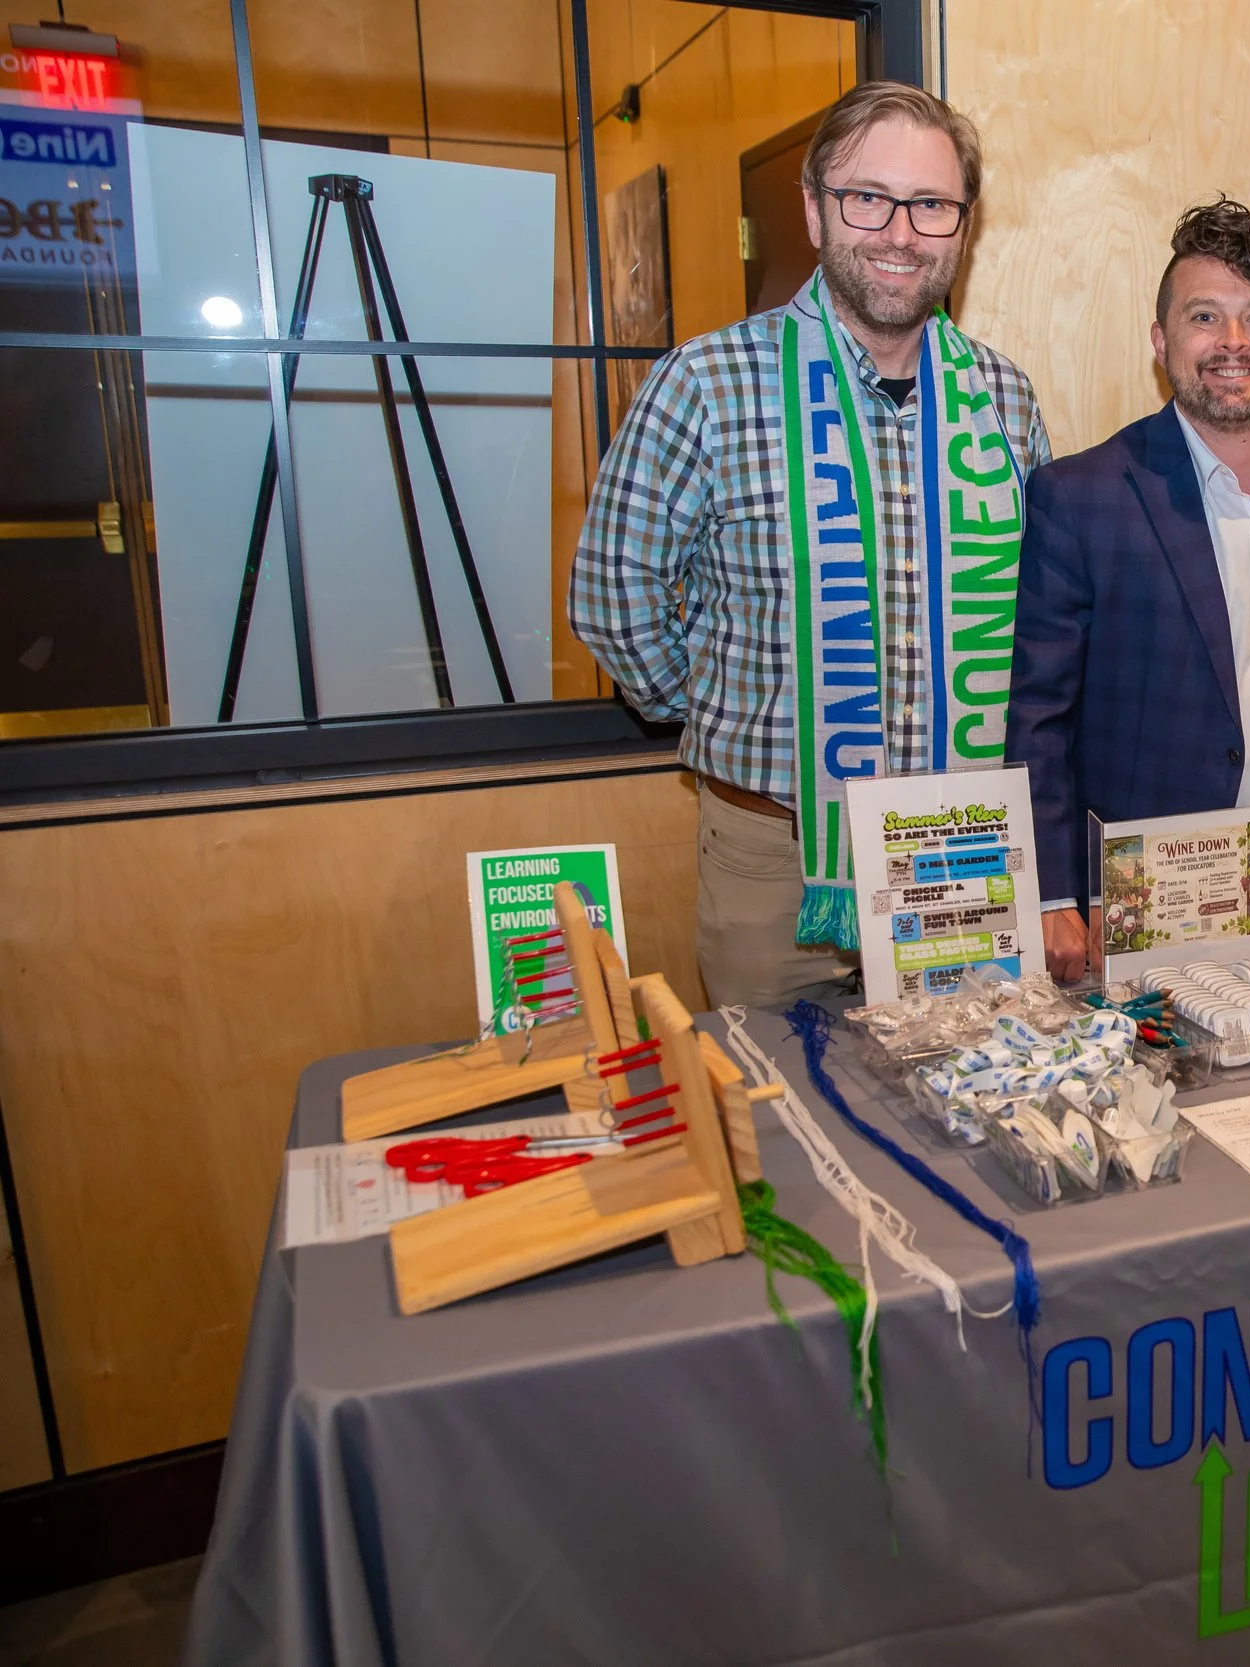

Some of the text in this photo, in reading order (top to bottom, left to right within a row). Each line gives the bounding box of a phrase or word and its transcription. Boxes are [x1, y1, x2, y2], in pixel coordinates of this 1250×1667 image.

[37, 55, 106, 110] EXIT
[883, 803, 1008, 832] Summer's Here
[883, 823, 1009, 842] SO ARE THE EVENTS!
[1157, 837, 1230, 859] WINE DOWN
[1209, 851, 1238, 860] CELEBRATION
[486, 857, 560, 881] LEARNING
[891, 860, 909, 870] May
[918, 861, 926, 869] 9
[956, 854, 999, 866] GARDEN
[1187, 861, 1216, 872] EDUCATORS
[488, 883, 555, 905] FOCUSED
[902, 883, 965, 896] CHICKEN &
[903, 893, 944, 904] PICKLE
[490, 904, 607, 932] ENVIRONTS
[896, 916, 914, 927] July
[923, 906, 1009, 922] SWING AROUND
[924, 917, 982, 929] FUN TOWN
[928, 966, 976, 979] KALDI
